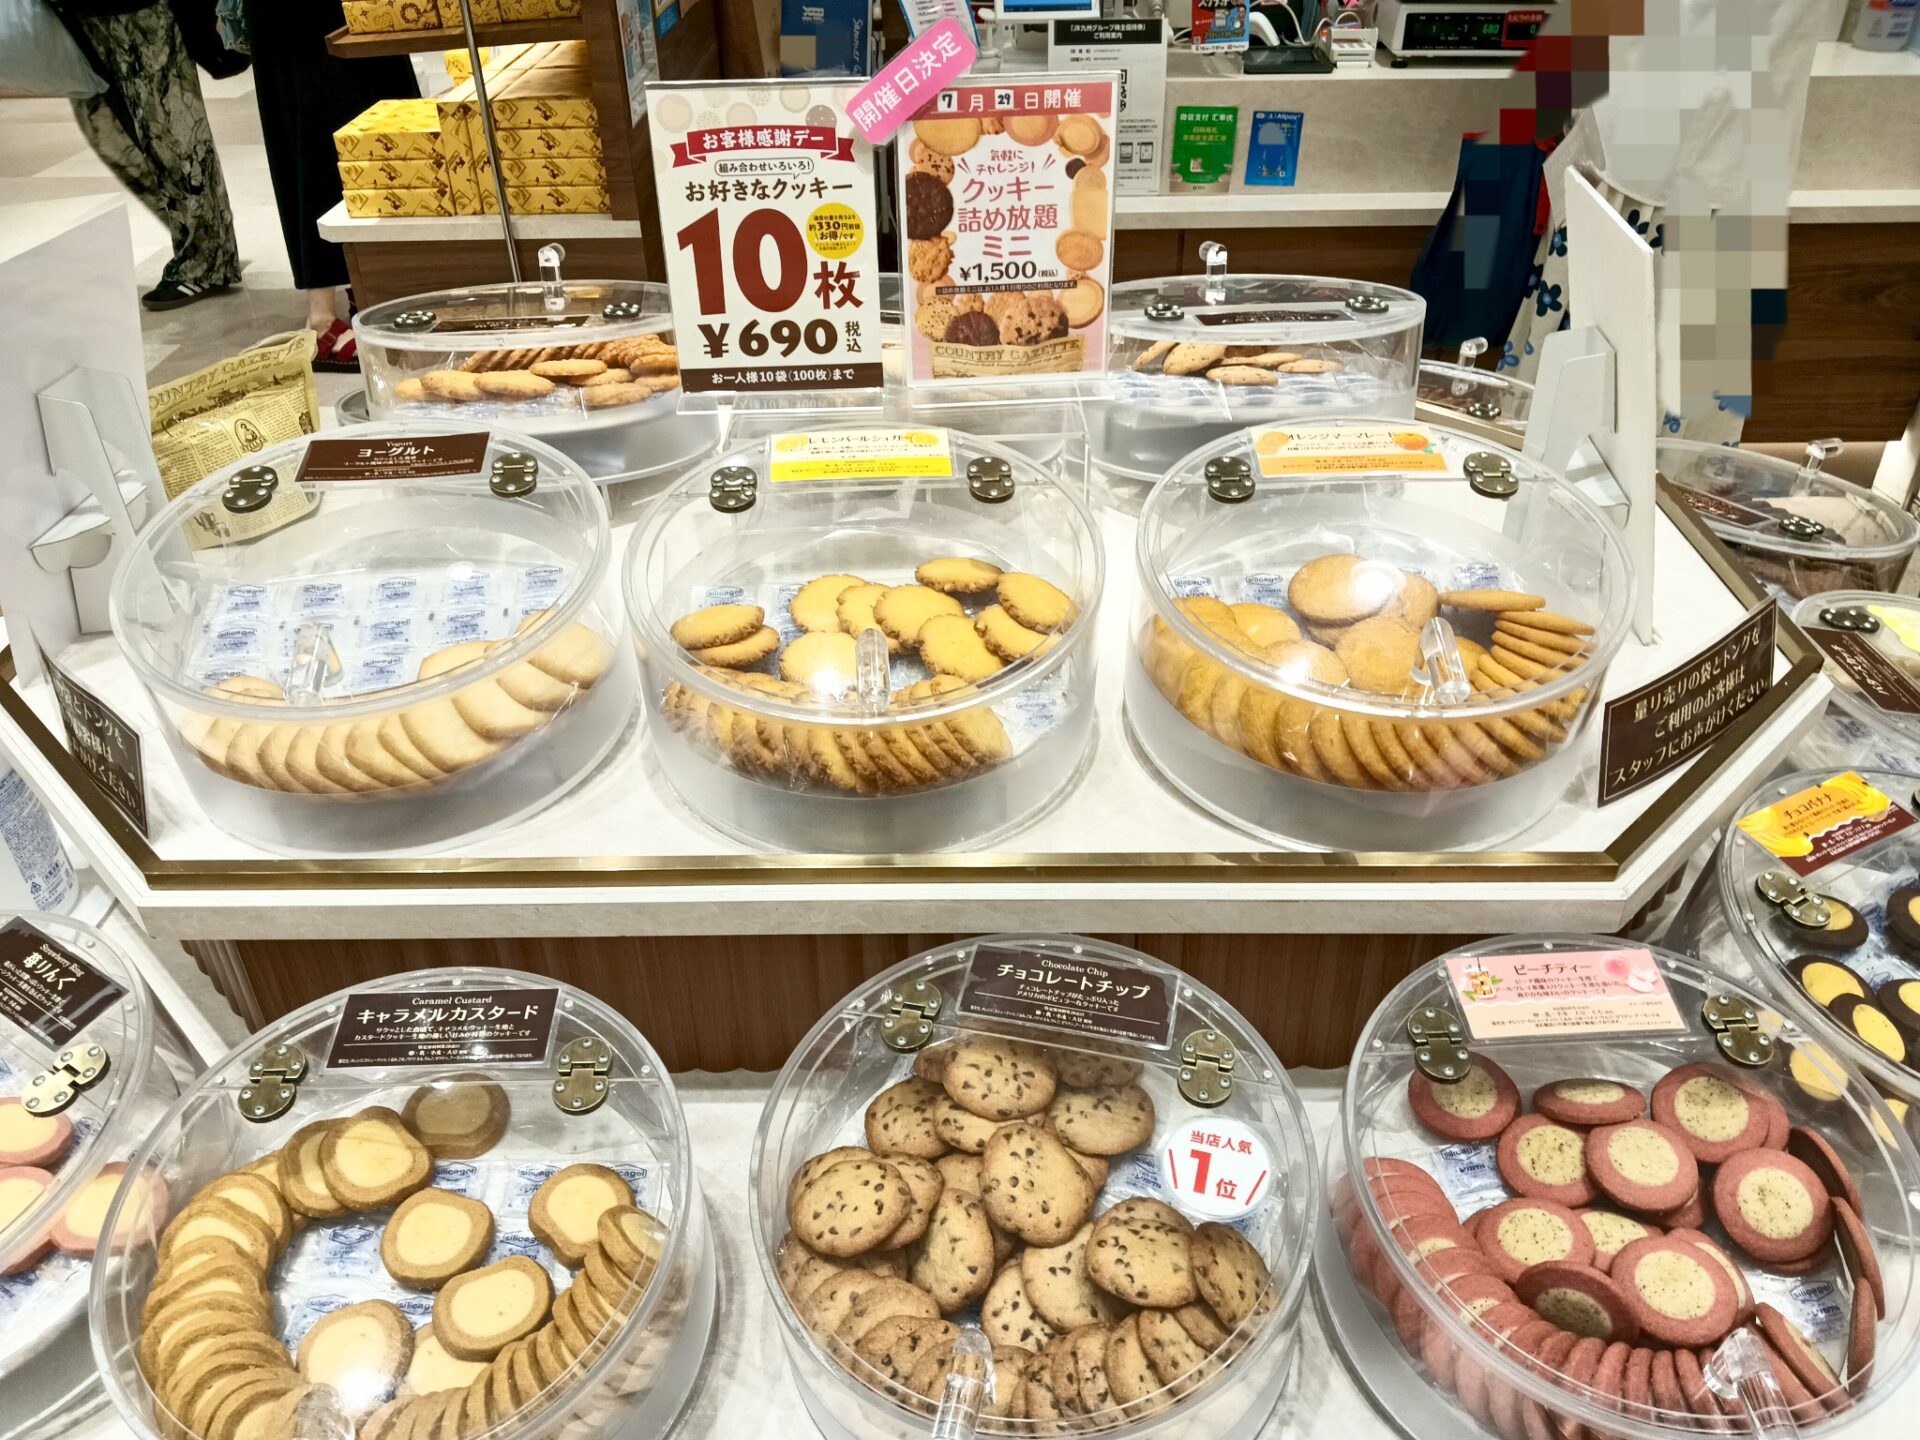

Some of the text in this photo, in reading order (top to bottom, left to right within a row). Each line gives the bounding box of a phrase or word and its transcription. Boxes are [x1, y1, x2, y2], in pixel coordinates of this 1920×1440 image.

[852, 29, 962, 133] 開催日決定
[703, 128, 824, 149] お客様感謝デー
[991, 149, 1024, 161] 気軽に
[685, 177, 853, 202] お好きなクッキー
[962, 176, 1055, 202] クッキー
[958, 204, 1059, 233] 詰め放題
[983, 236, 1032, 258] ミニ
[697, 318, 862, 358] ¥690 税込
[935, 346, 1006, 361] COUNTRY
[1011, 339, 1080, 360] GAZETTE
[149, 369, 218, 409] OUNTRY
[357, 446, 435, 458] ヨーグルト
[1634, 627, 1761, 723] 量り売りの袋とトングを
[1655, 665, 1746, 738] ご利用のお客様は
[1612, 678, 1768, 787] スタッフにお声がけください。
[40, 943, 85, 977] Strawberry Ring
[1041, 959, 1109, 978] Chocolate Chip
[1513, 963, 1592, 976] ピーチティー
[997, 964, 1150, 999] チョコレートチップ
[412, 996, 492, 1005] Caramel Custard
[1016, 991, 1119, 1012] アメリカのポピュラーなクッキーです
[1018, 983, 1120, 1007] チョコレートチップがたっぷり入った
[356, 1005, 539, 1024] キャラメルカスタード
[1190, 1130, 1253, 1155] 当店人気
[1190, 1149, 1238, 1200] 1位
